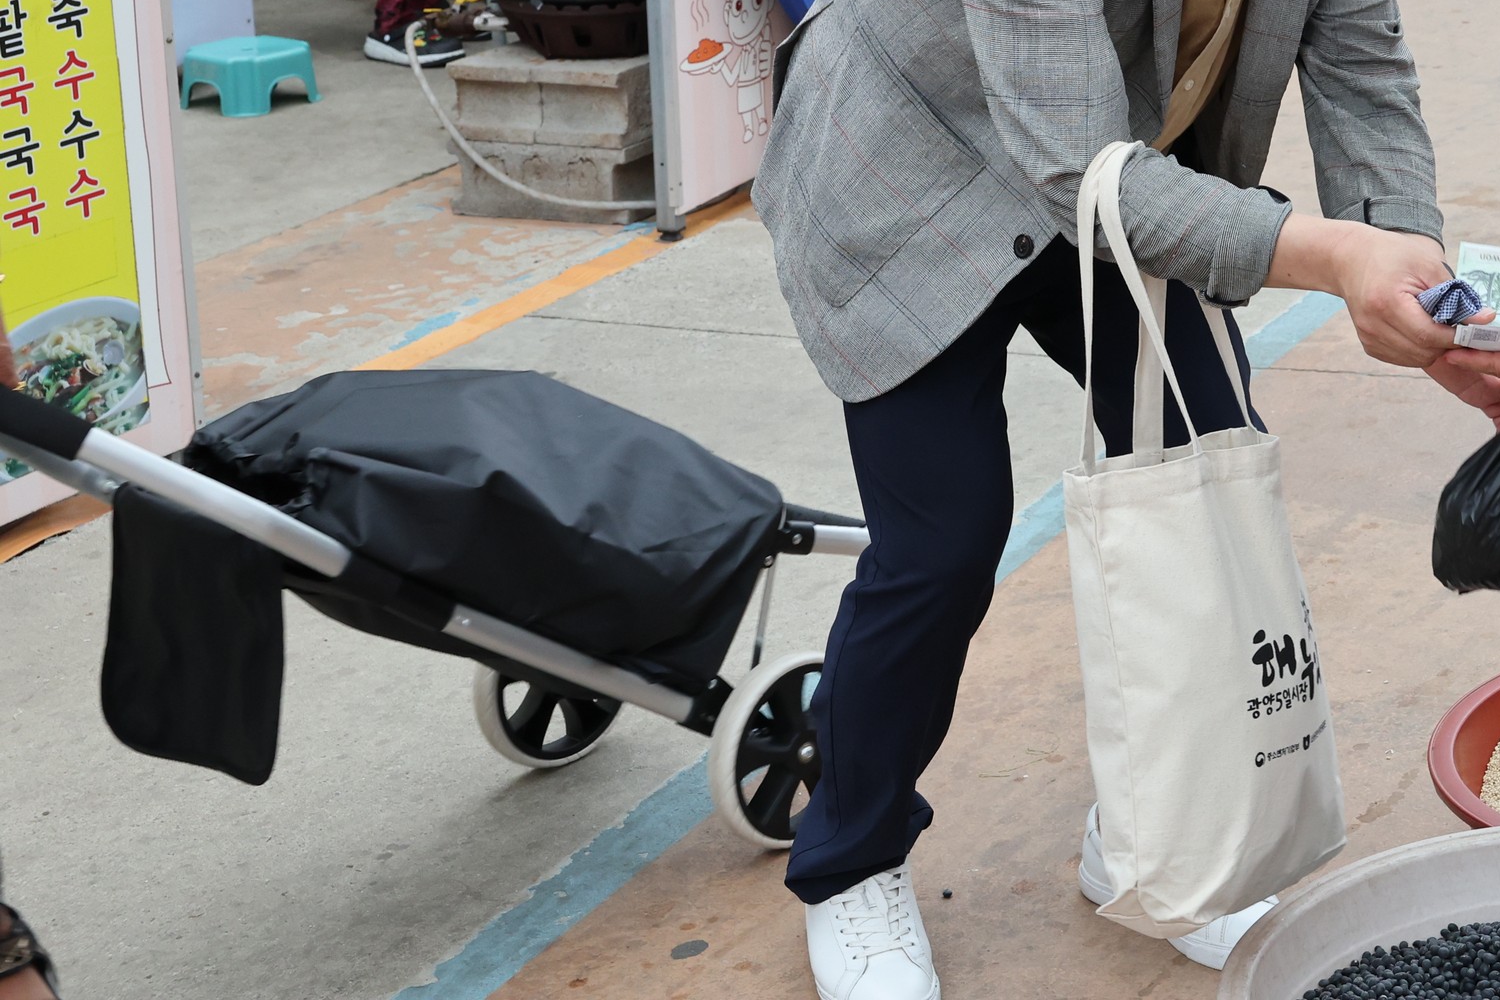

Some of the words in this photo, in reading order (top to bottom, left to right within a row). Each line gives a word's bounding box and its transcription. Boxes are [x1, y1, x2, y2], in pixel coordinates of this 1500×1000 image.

[1479, 252, 1500, 263] won
[1247, 681, 1309, 719] 광양5일시장
[1266, 743, 1300, 762] 중소벤처기업부
